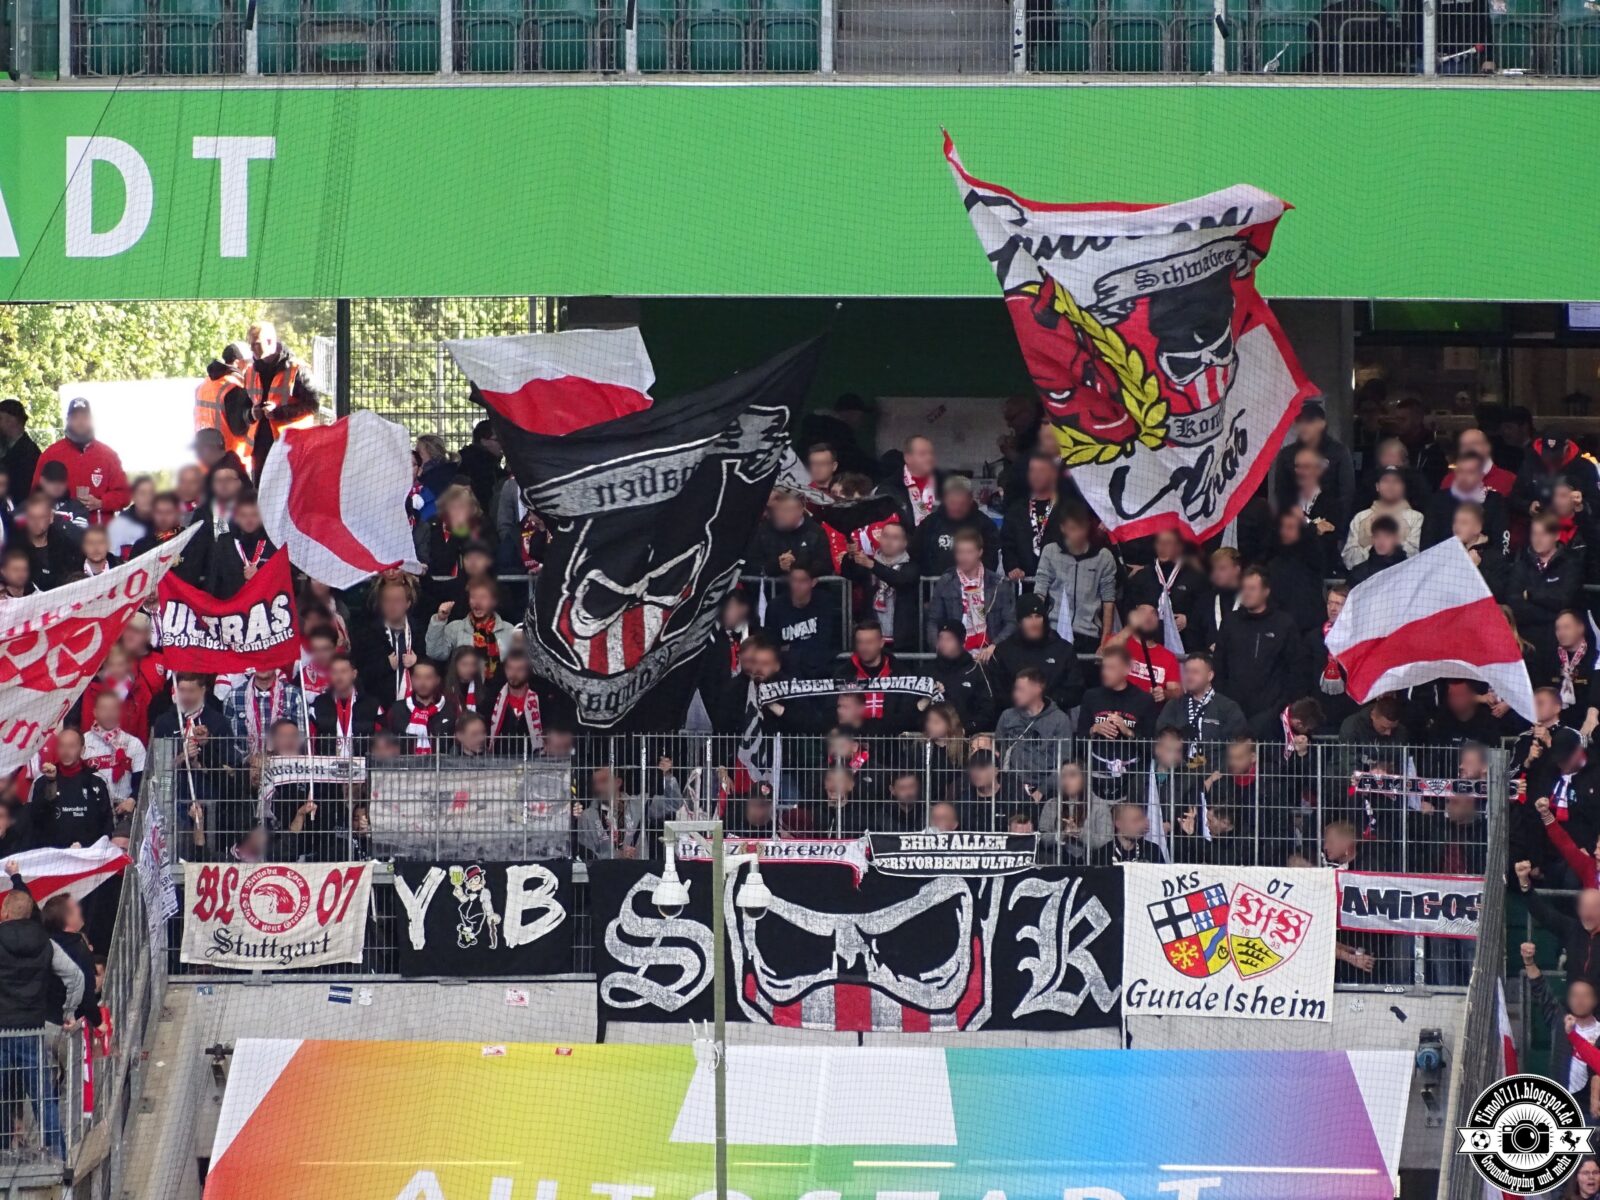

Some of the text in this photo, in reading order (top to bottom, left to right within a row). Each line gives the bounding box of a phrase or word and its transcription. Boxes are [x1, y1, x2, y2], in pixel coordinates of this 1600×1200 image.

[0, 136, 276, 258] DT
[163, 594, 291, 644] ULTRAS
[682, 844, 846, 856] PFZ INFERNO
[899, 835, 1008, 850] EHRE ALLEN
[875, 856, 1032, 870] VERSTORBENEN ULTRAS
[317, 866, 366, 927] 07
[1162, 871, 1200, 897] DKS
[1267, 878, 1294, 900] 07
[394, 864, 567, 950] Y B
[1232, 892, 1306, 945] VfB
[205, 928, 332, 966] Stuttgart
[1126, 978, 1325, 1019] Gundelsheim
